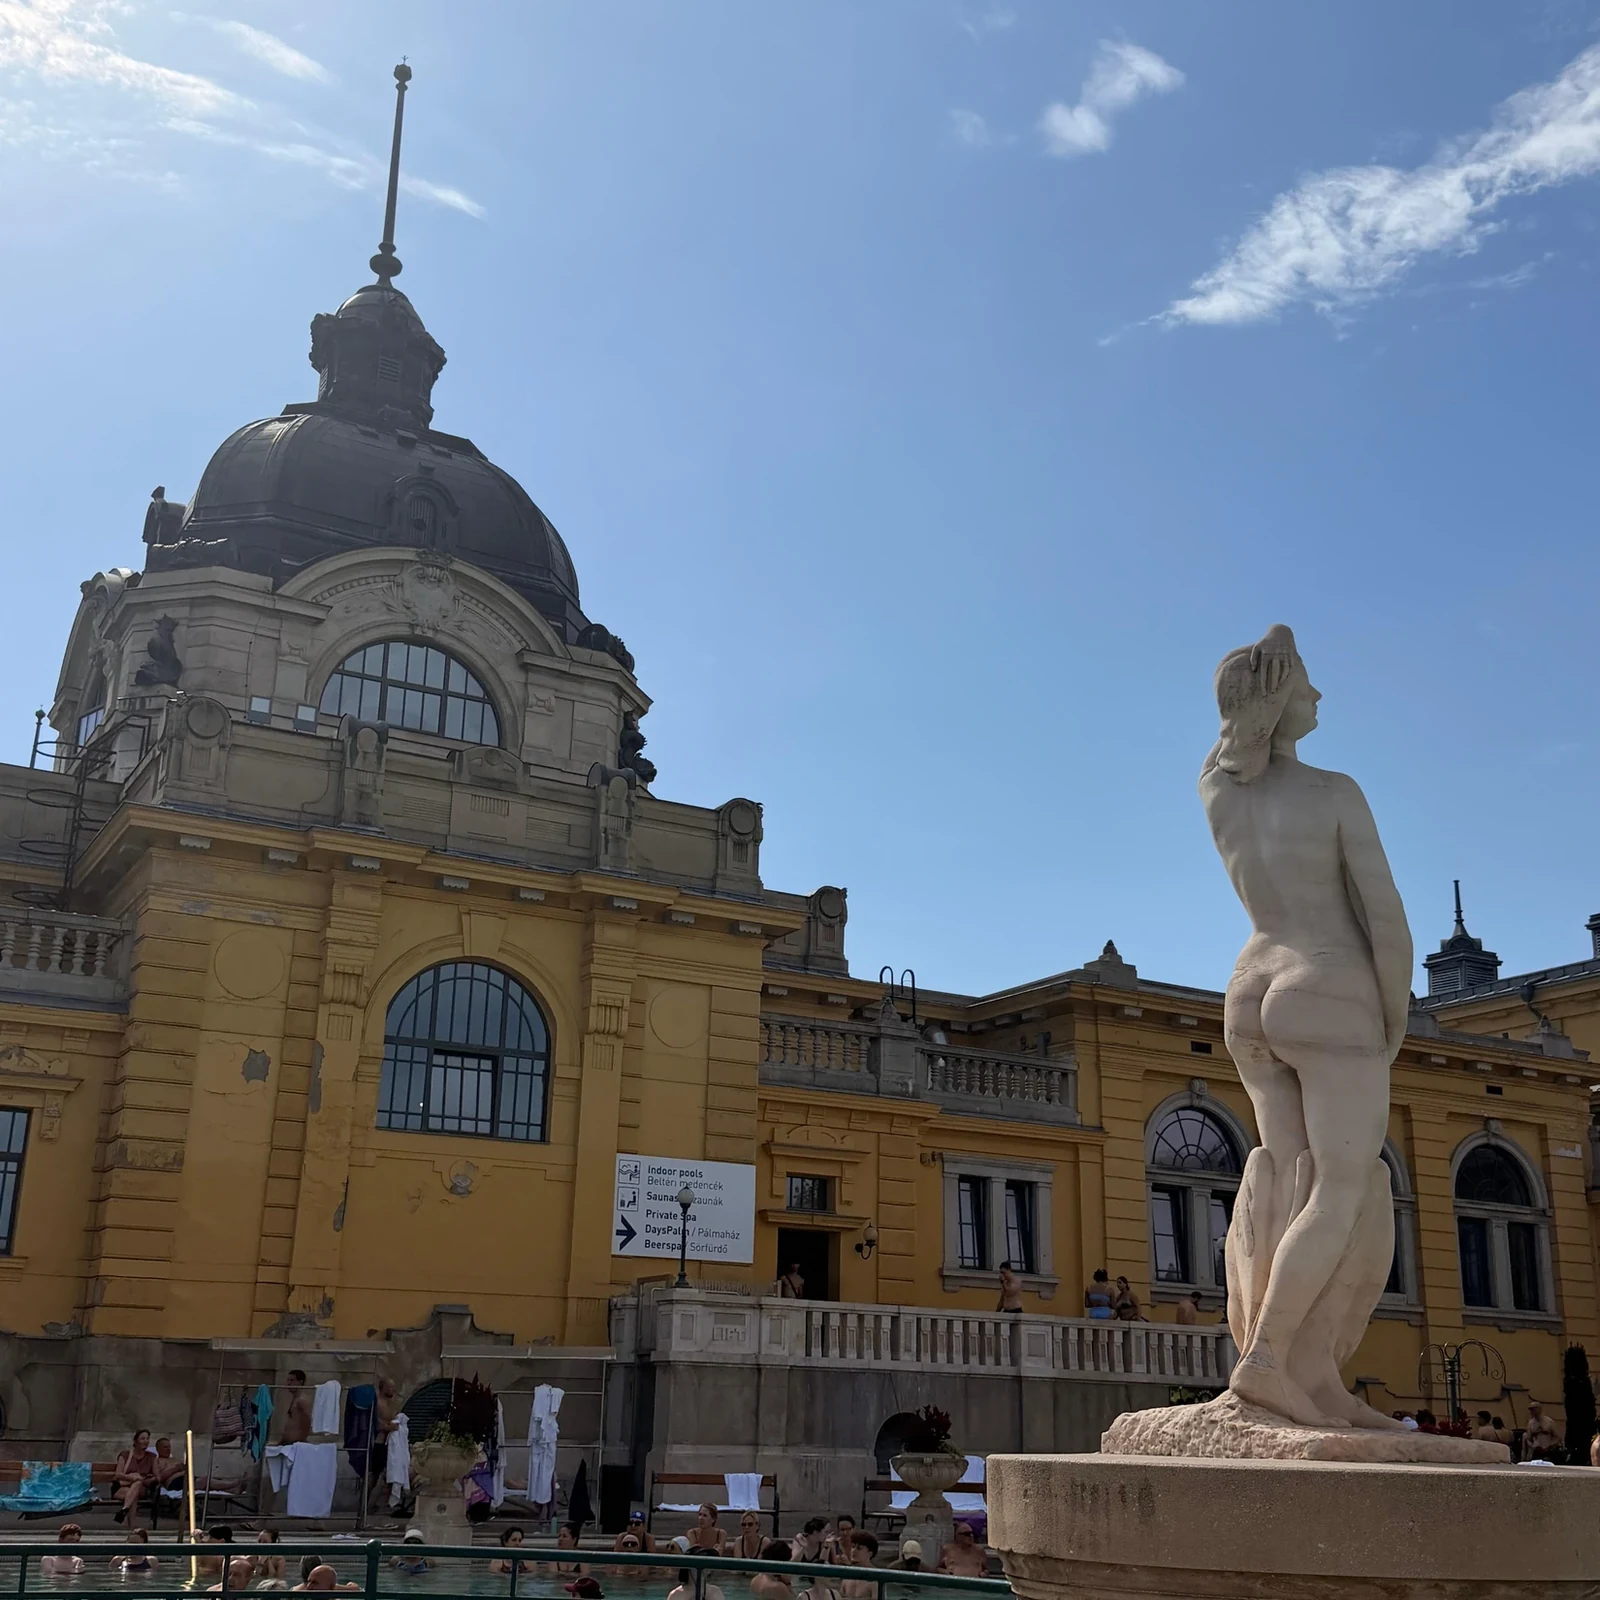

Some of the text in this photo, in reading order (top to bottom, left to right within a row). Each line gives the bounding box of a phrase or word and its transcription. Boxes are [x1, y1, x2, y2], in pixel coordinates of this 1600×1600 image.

[648, 1165, 703, 1179] Indoor pools
[647, 1176, 724, 1191] Beltéri medencék
[646, 1192, 724, 1206] Saunas zaunák
[646, 1209, 678, 1221] Private
[698, 1227, 740, 1240] Pálmaház
[644, 1239, 728, 1254] Beerspa Sörfürdő
